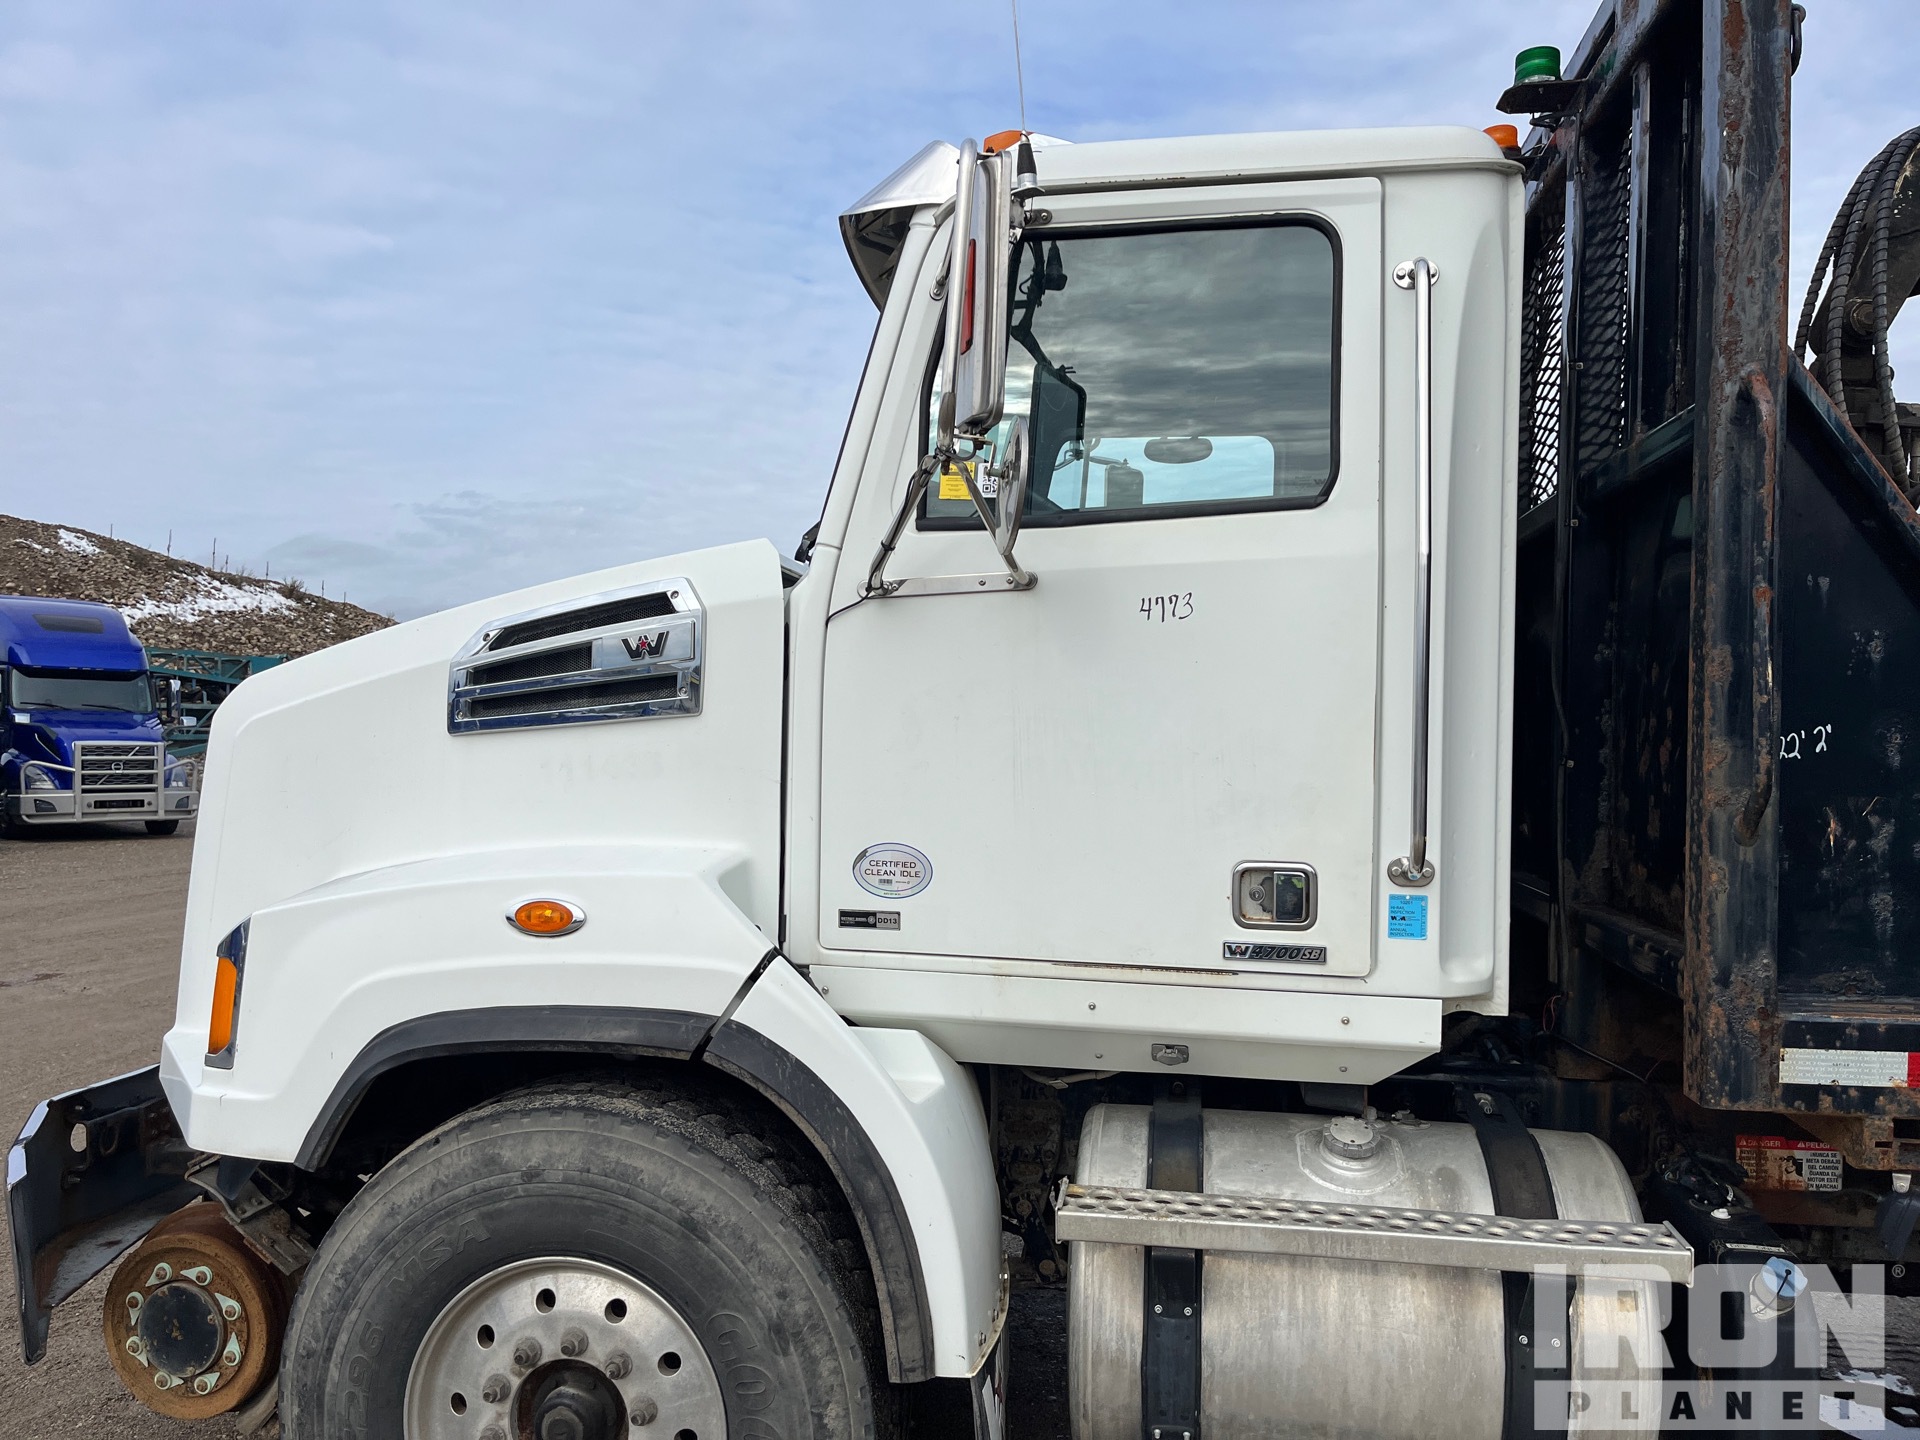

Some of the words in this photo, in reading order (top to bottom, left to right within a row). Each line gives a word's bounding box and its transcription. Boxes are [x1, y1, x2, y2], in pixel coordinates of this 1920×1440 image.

[1139, 591, 1194, 623] 4773
[868, 859, 917, 869] CERTIFIED
[864, 868, 896, 877] CLEAN
[899, 870, 921, 878] IDLE
[877, 917, 898, 925] DD13
[1805, 1141, 1831, 1149] PELIG
